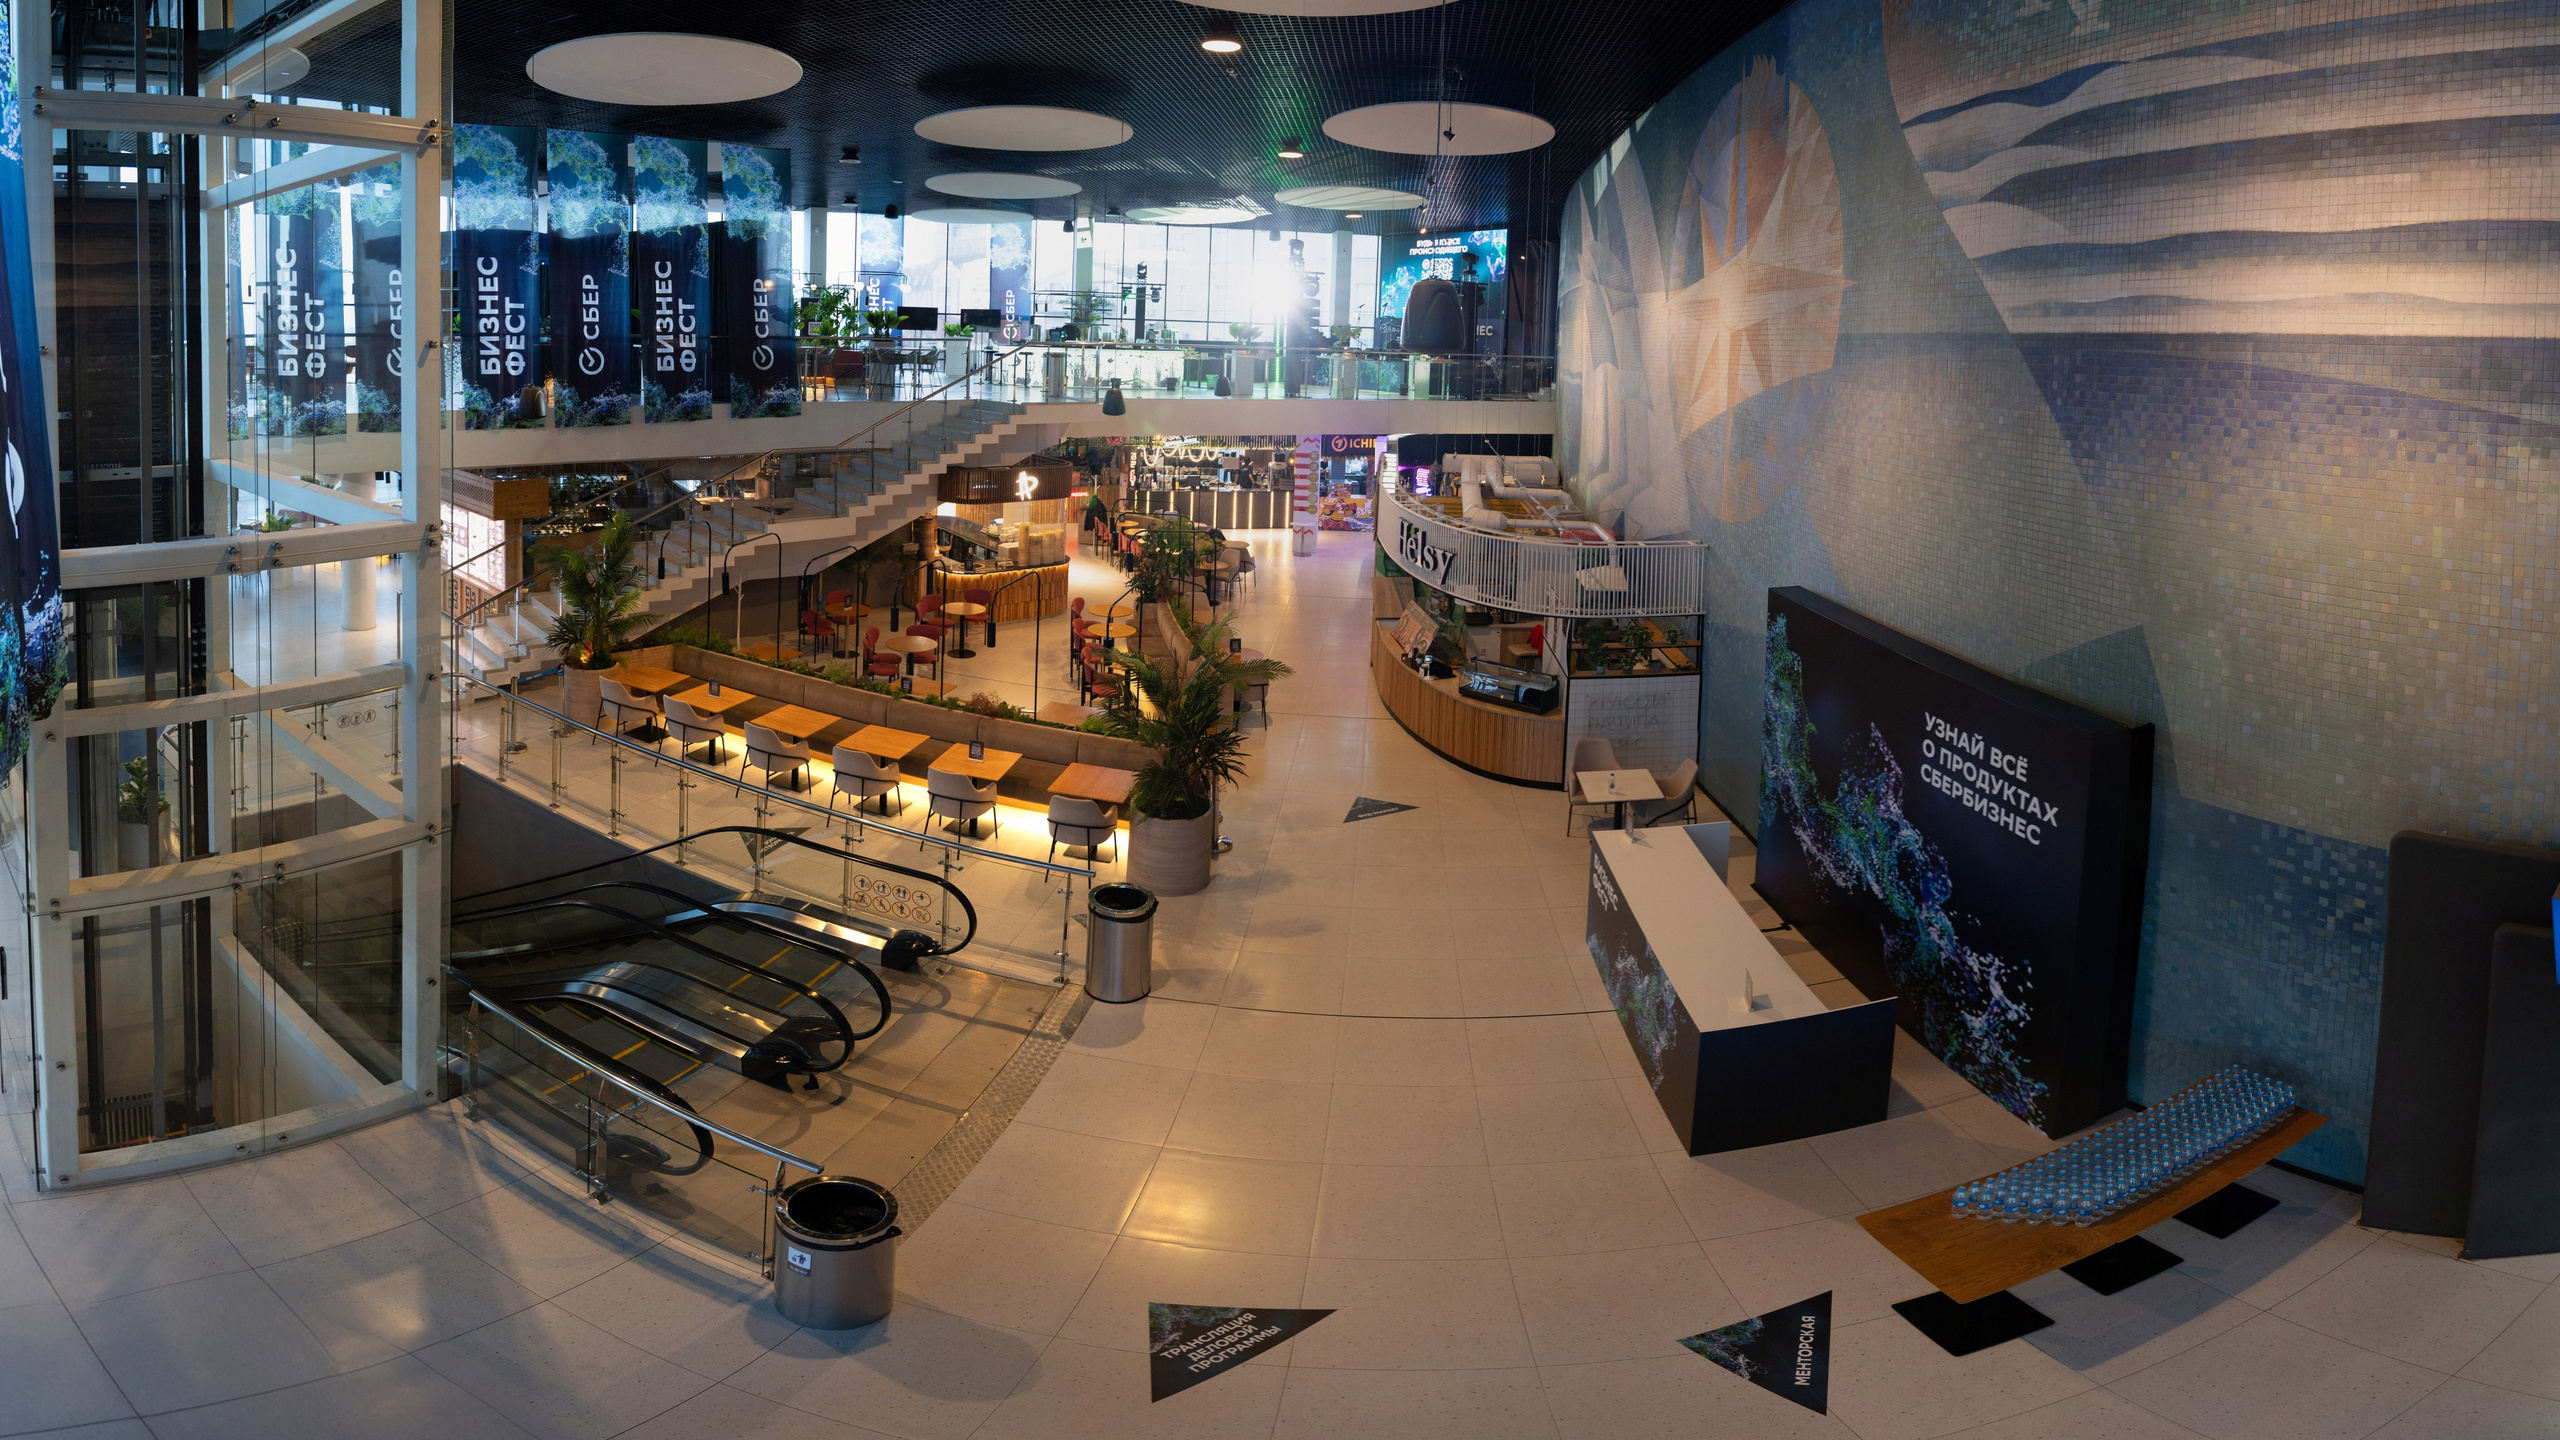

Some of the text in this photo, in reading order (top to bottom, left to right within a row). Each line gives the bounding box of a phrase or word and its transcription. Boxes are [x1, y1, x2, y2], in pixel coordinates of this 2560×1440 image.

[276, 248, 298, 376] БИЗНЕС
[304, 292, 326, 378] ФЕСТ
[477, 257, 500, 375] БИЗНЕС
[504, 297, 525, 376] ФЕСТ
[582, 274, 600, 340] СБЕР
[654, 261, 674, 371] БИЗНЕС
[678, 298, 696, 372] ФЕСТ
[753, 278, 769, 338] СБЕР
[1006, 289, 1015, 322] СБЕР
[1924, 711, 2028, 782] УЗНАЙ ВСЁ
[1920, 764, 2041, 846] СБЕРБИЗНЕС
[1922, 739, 2059, 827] О ПРОДУКТАХ
[1592, 872, 1609, 911] ФЕСТ
[1593, 852, 1618, 911] БИЗНЕС
[1160, 1312, 1257, 1358] ТРАНСЛЯЦИЯ
[1187, 1324, 1259, 1362] ДЕЛОВОЙ
[1188, 1325, 1282, 1372] ПРОГРАММЫ
[1794, 1315, 1816, 1386] МЕНТОРСКАЯ
